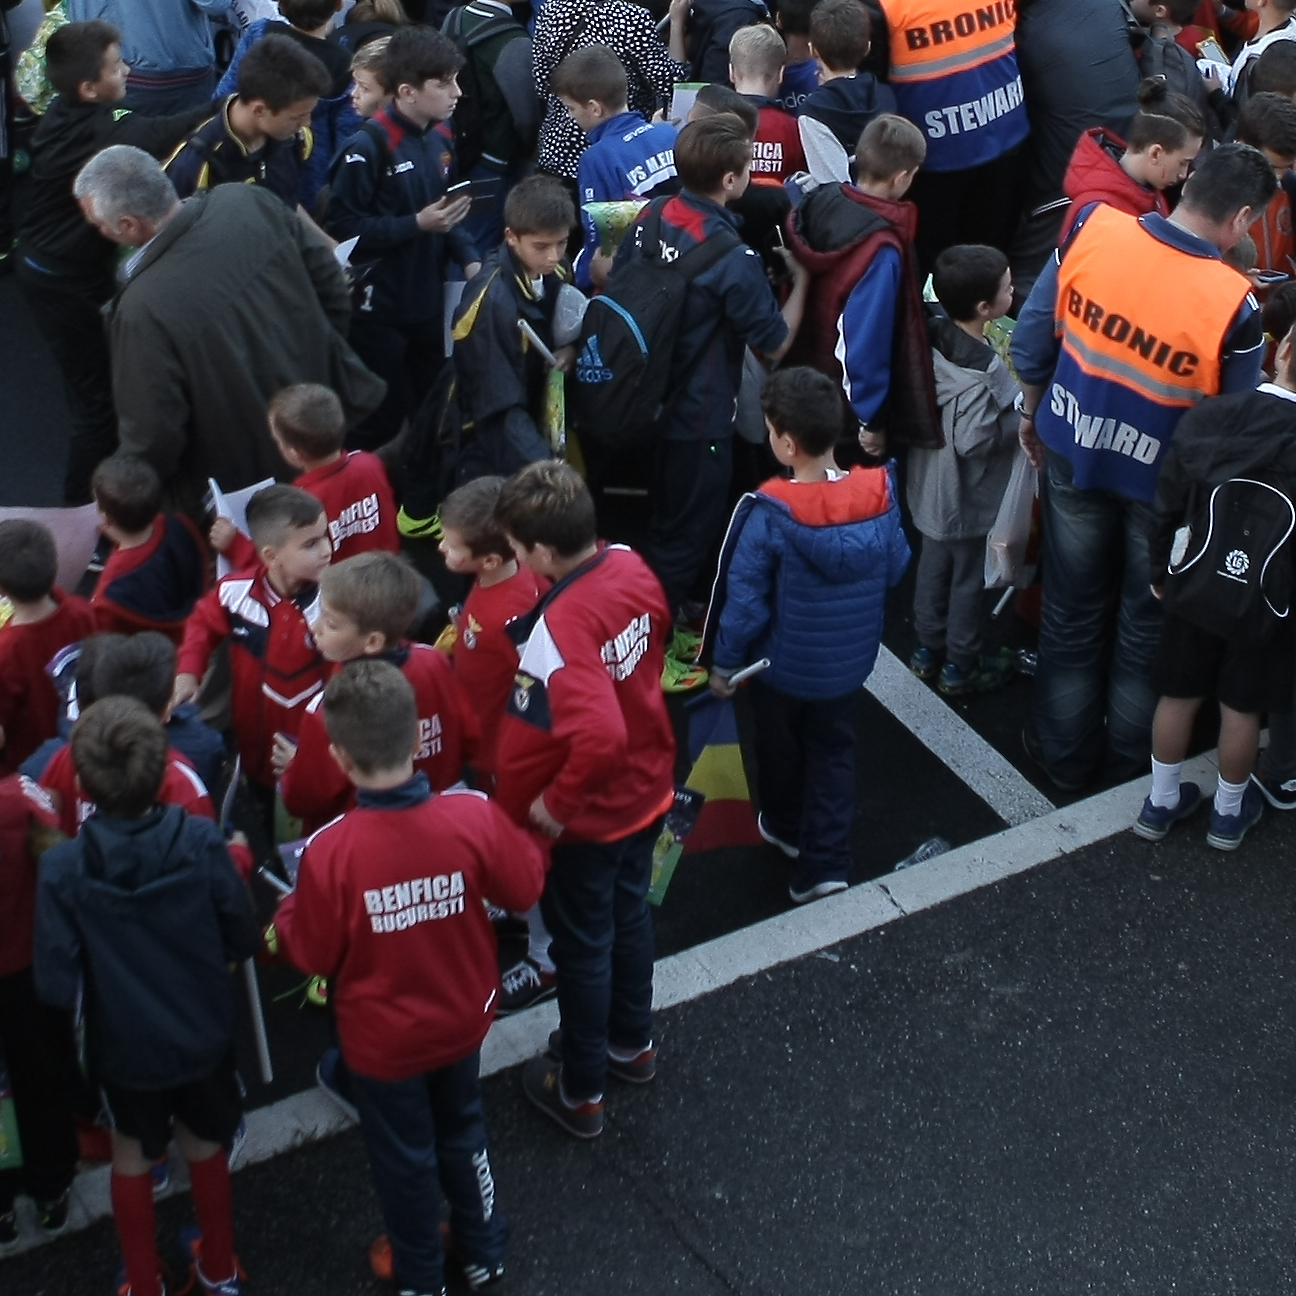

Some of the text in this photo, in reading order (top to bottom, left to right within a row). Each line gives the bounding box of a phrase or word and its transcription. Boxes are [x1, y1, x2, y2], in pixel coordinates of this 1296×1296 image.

[625, 164, 648, 186] LPS
[360, 285, 374, 312] 1
[1068, 287, 1200, 378] BRONIC
[1050, 381, 1162, 467] STWARD
[363, 870, 466, 916] BENFICA
[369, 894, 465, 934] BUCURESTI
